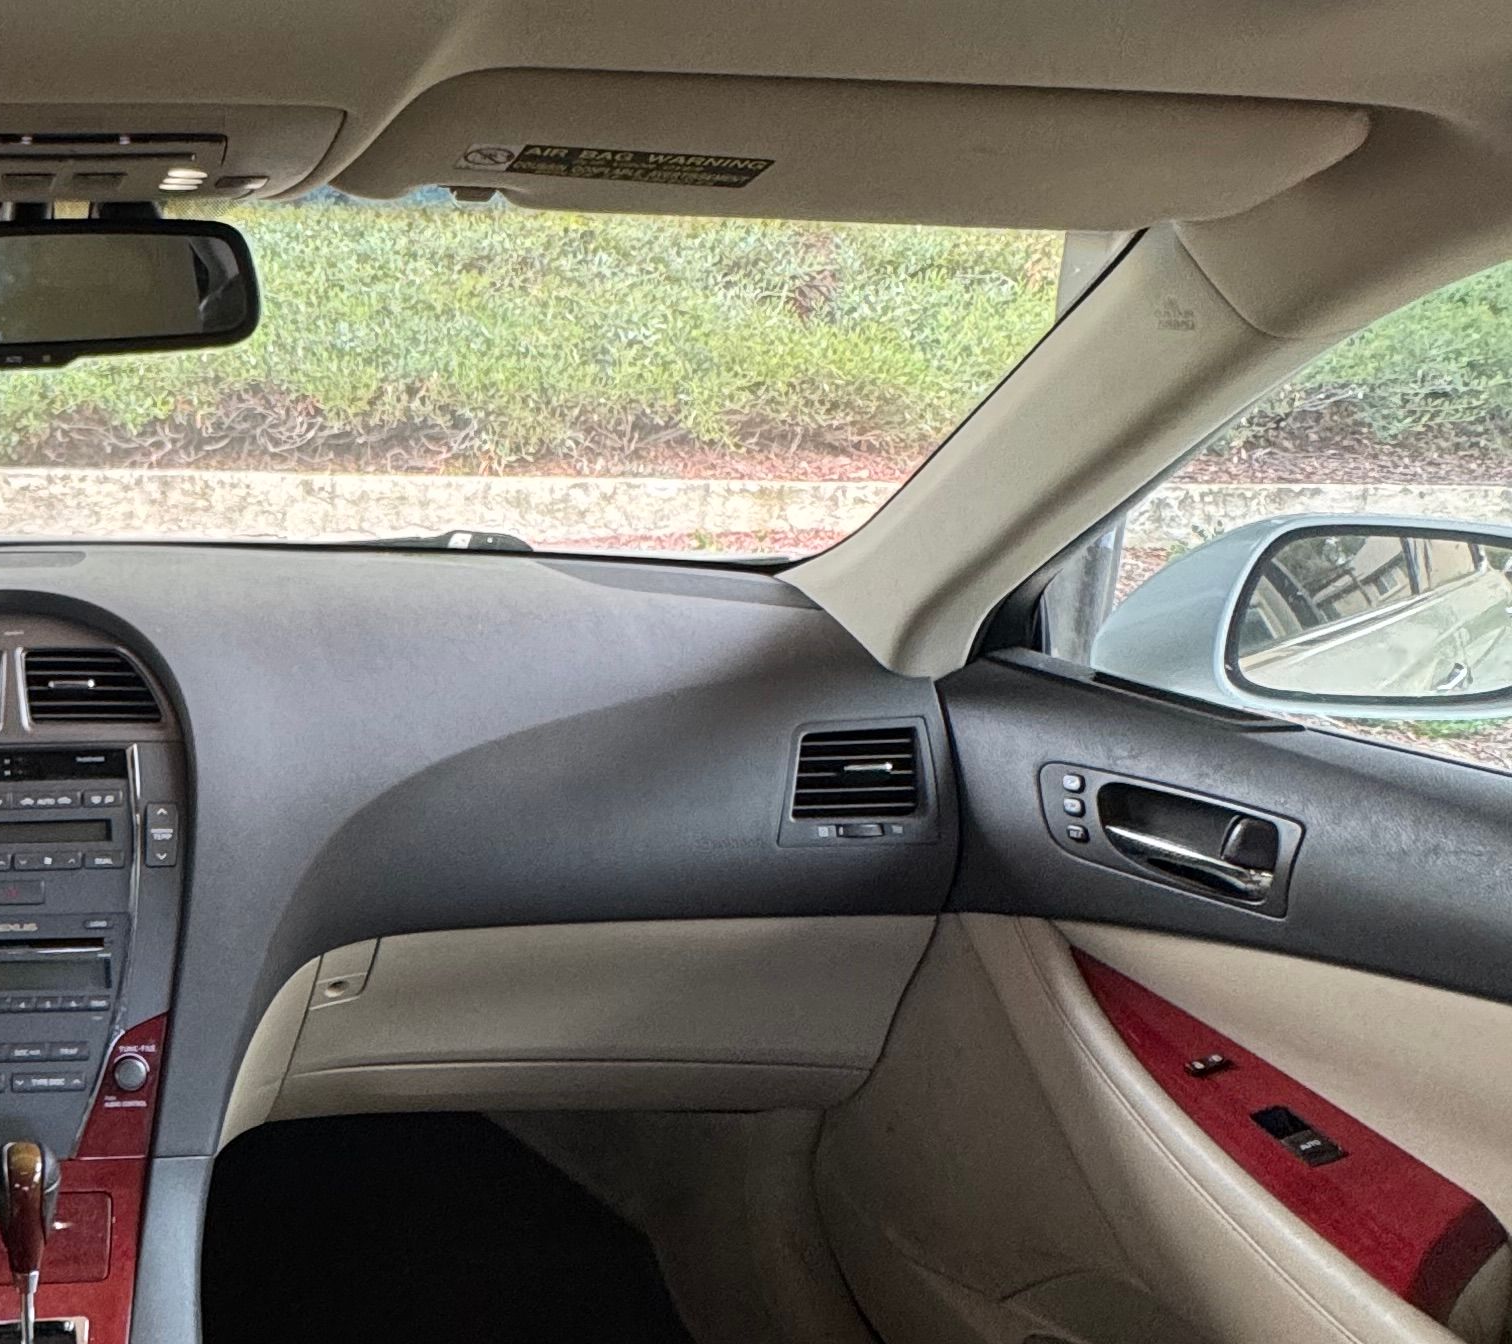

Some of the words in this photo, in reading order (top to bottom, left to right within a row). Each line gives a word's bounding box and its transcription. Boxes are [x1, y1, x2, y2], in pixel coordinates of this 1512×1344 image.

[527, 147, 569, 158] AIR
[579, 150, 634, 162] BAG
[648, 154, 768, 171] WARNING
[37, 797, 56, 806] AUTO
[152, 833, 173, 841] TEMP
[1299, 1140, 1321, 1151] AUTO
